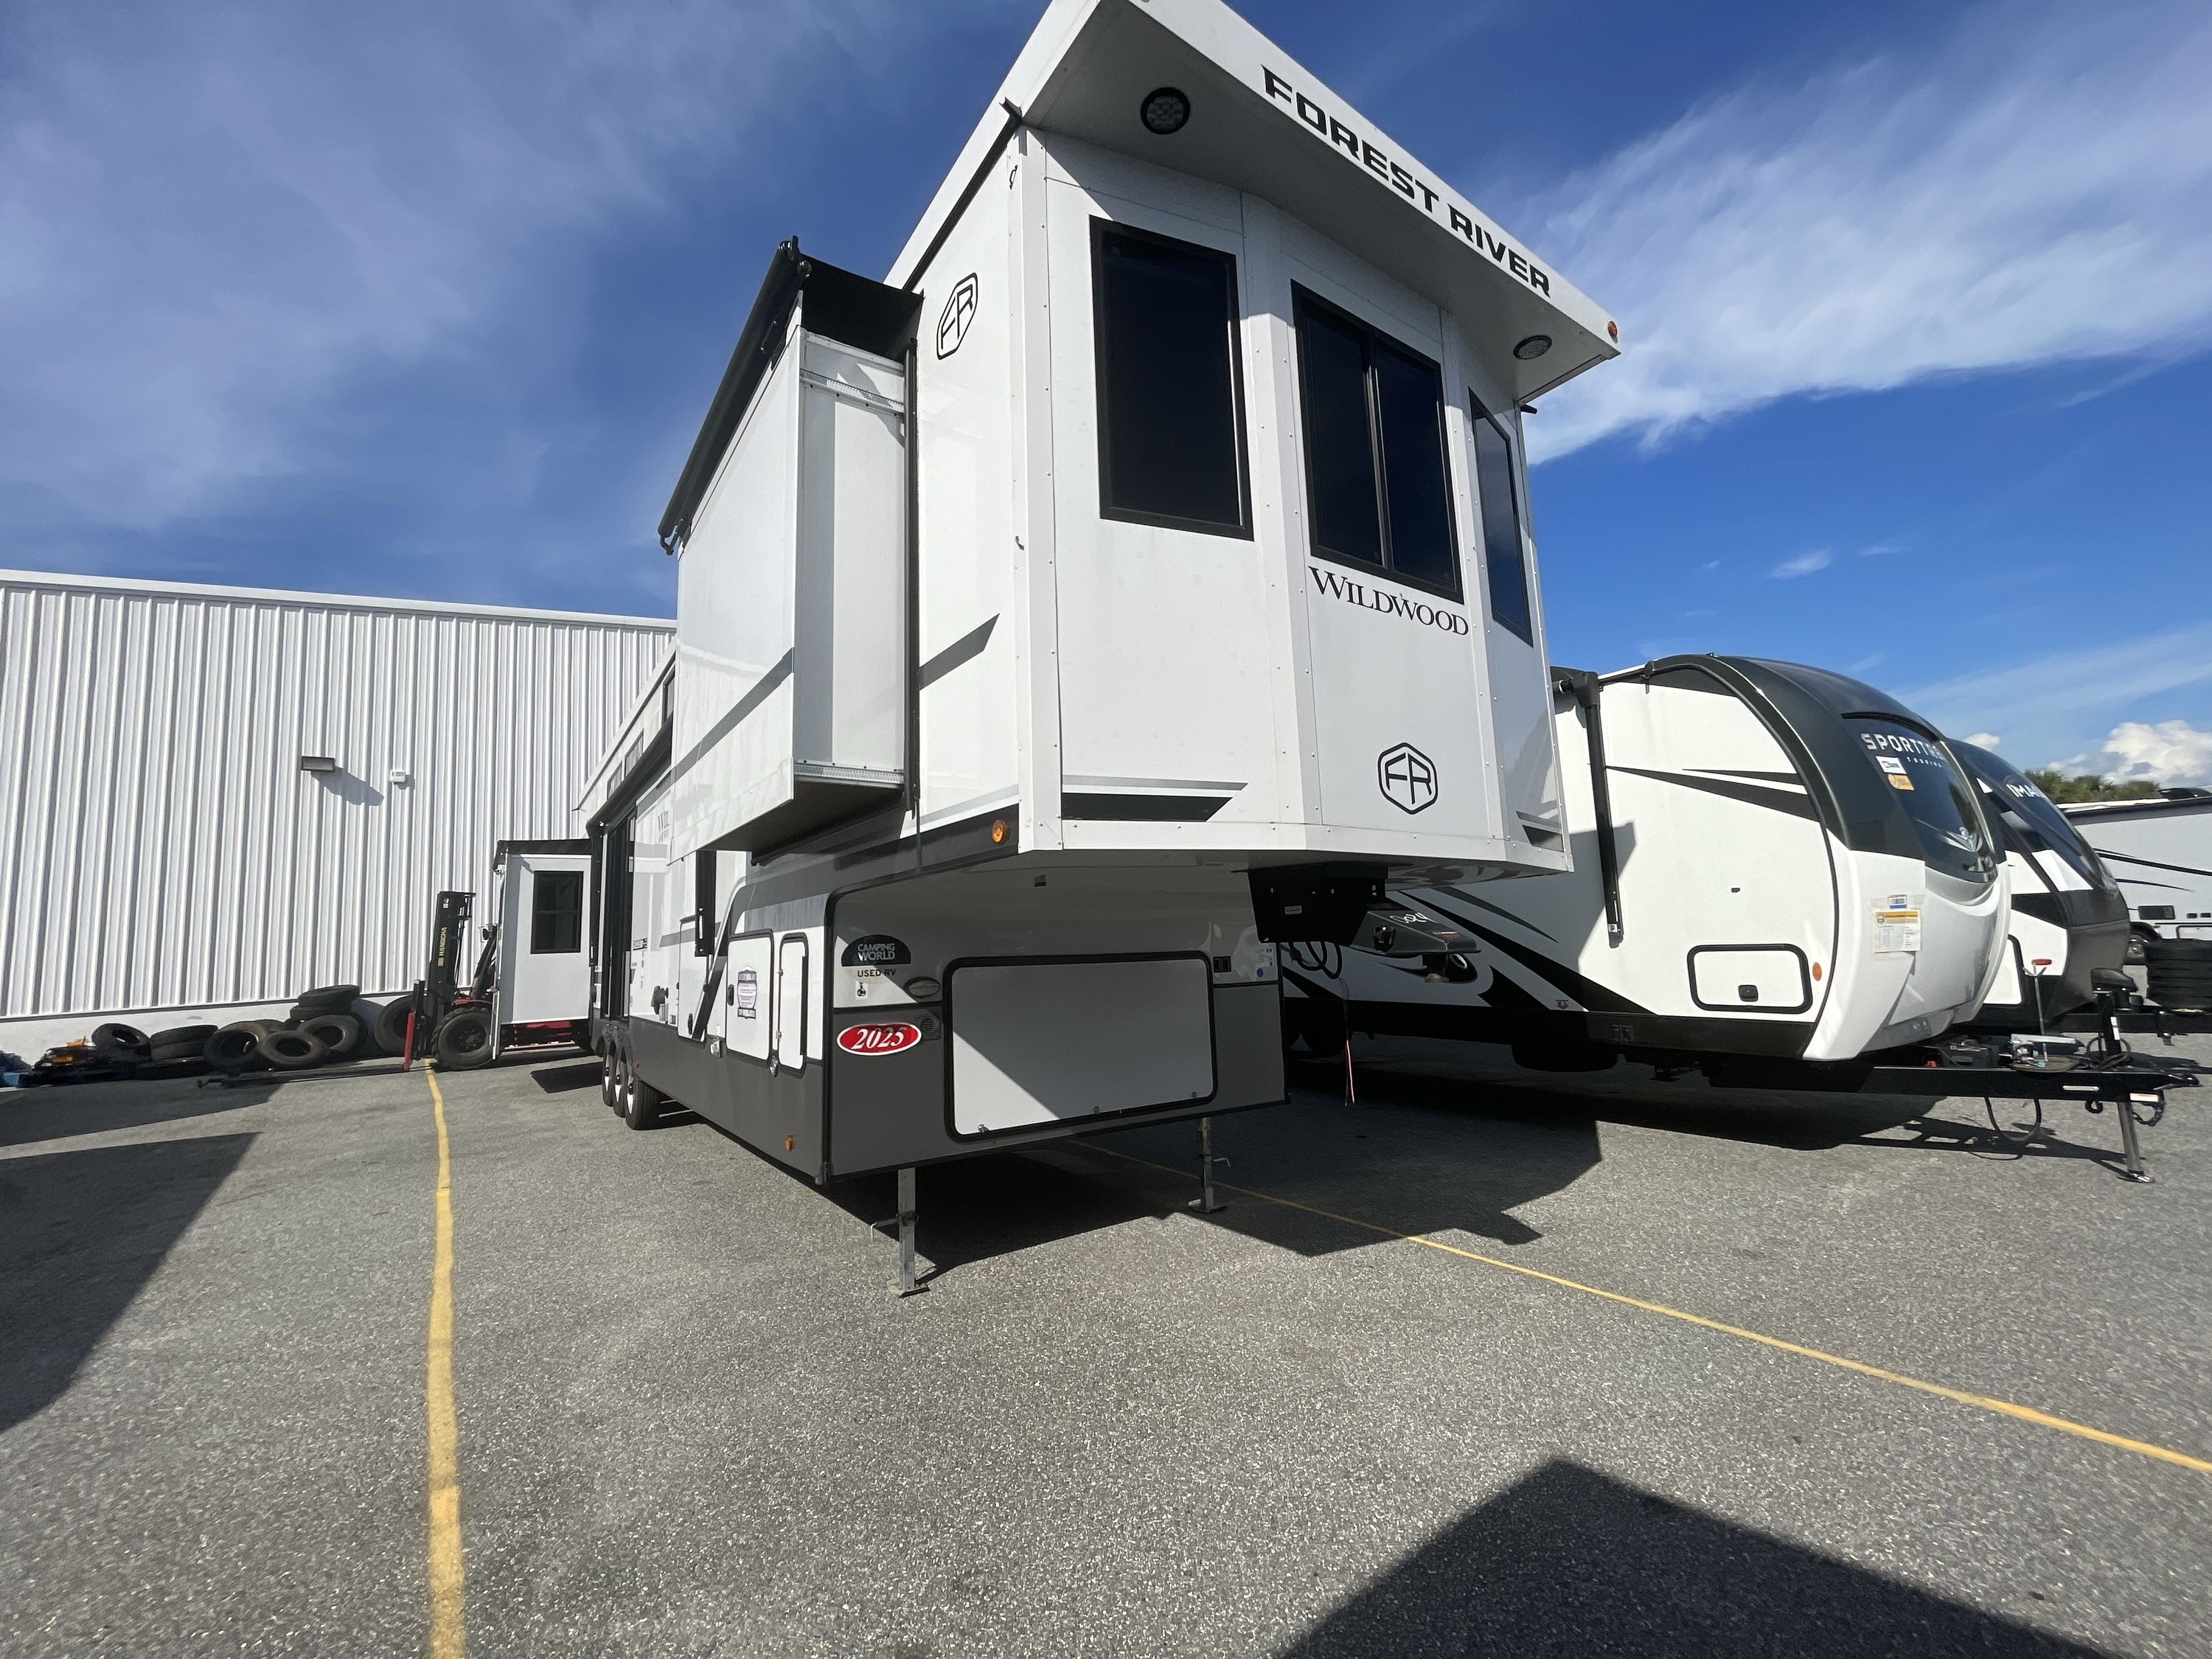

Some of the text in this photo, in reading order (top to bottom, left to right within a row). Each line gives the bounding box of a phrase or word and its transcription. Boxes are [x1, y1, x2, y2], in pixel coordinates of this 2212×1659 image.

[1261, 64, 1551, 298] FOREST RIVER
[1308, 566, 1469, 636] WILDWOOD
[1385, 752, 1432, 804] FR
[858, 943, 896, 952] CAMPING
[858, 951, 896, 961] WORLD
[858, 968, 897, 978] USED RV
[851, 1026, 908, 1050] 2025
